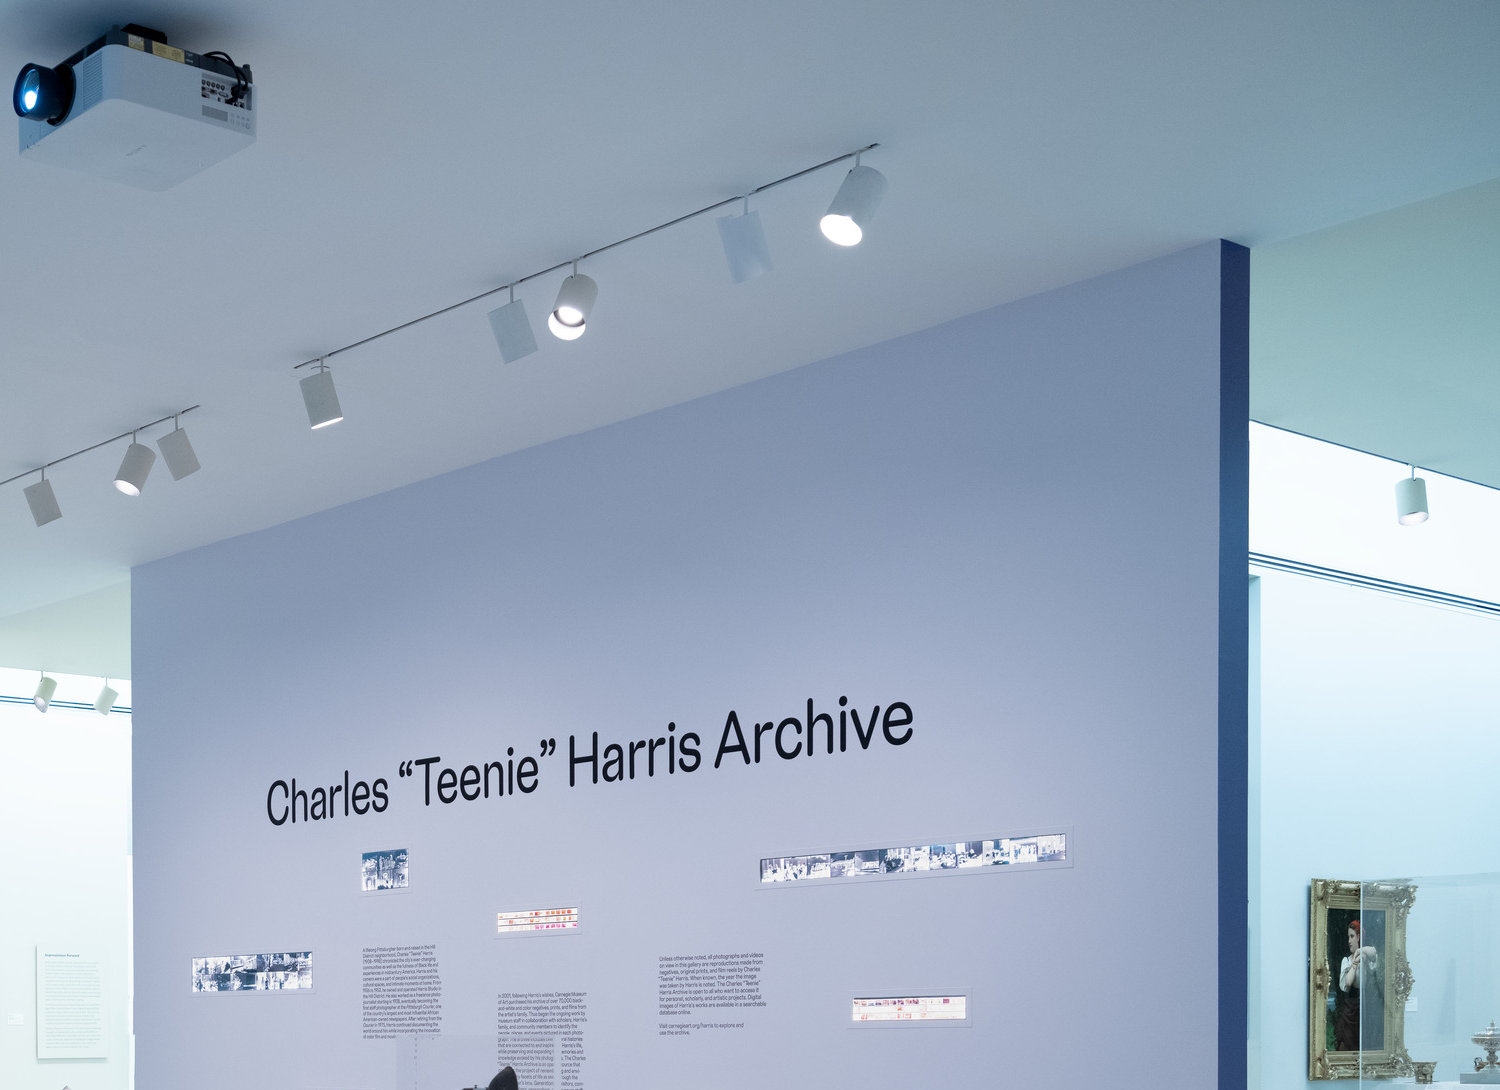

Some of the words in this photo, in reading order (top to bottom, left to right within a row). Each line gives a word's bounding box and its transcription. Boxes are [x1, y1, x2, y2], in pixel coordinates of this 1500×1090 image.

[267, 770, 389, 826] Charles
[398, 738, 556, 807] “Teenie”
[569, 721, 702, 788] Harris
[714, 695, 914, 769] Archive
